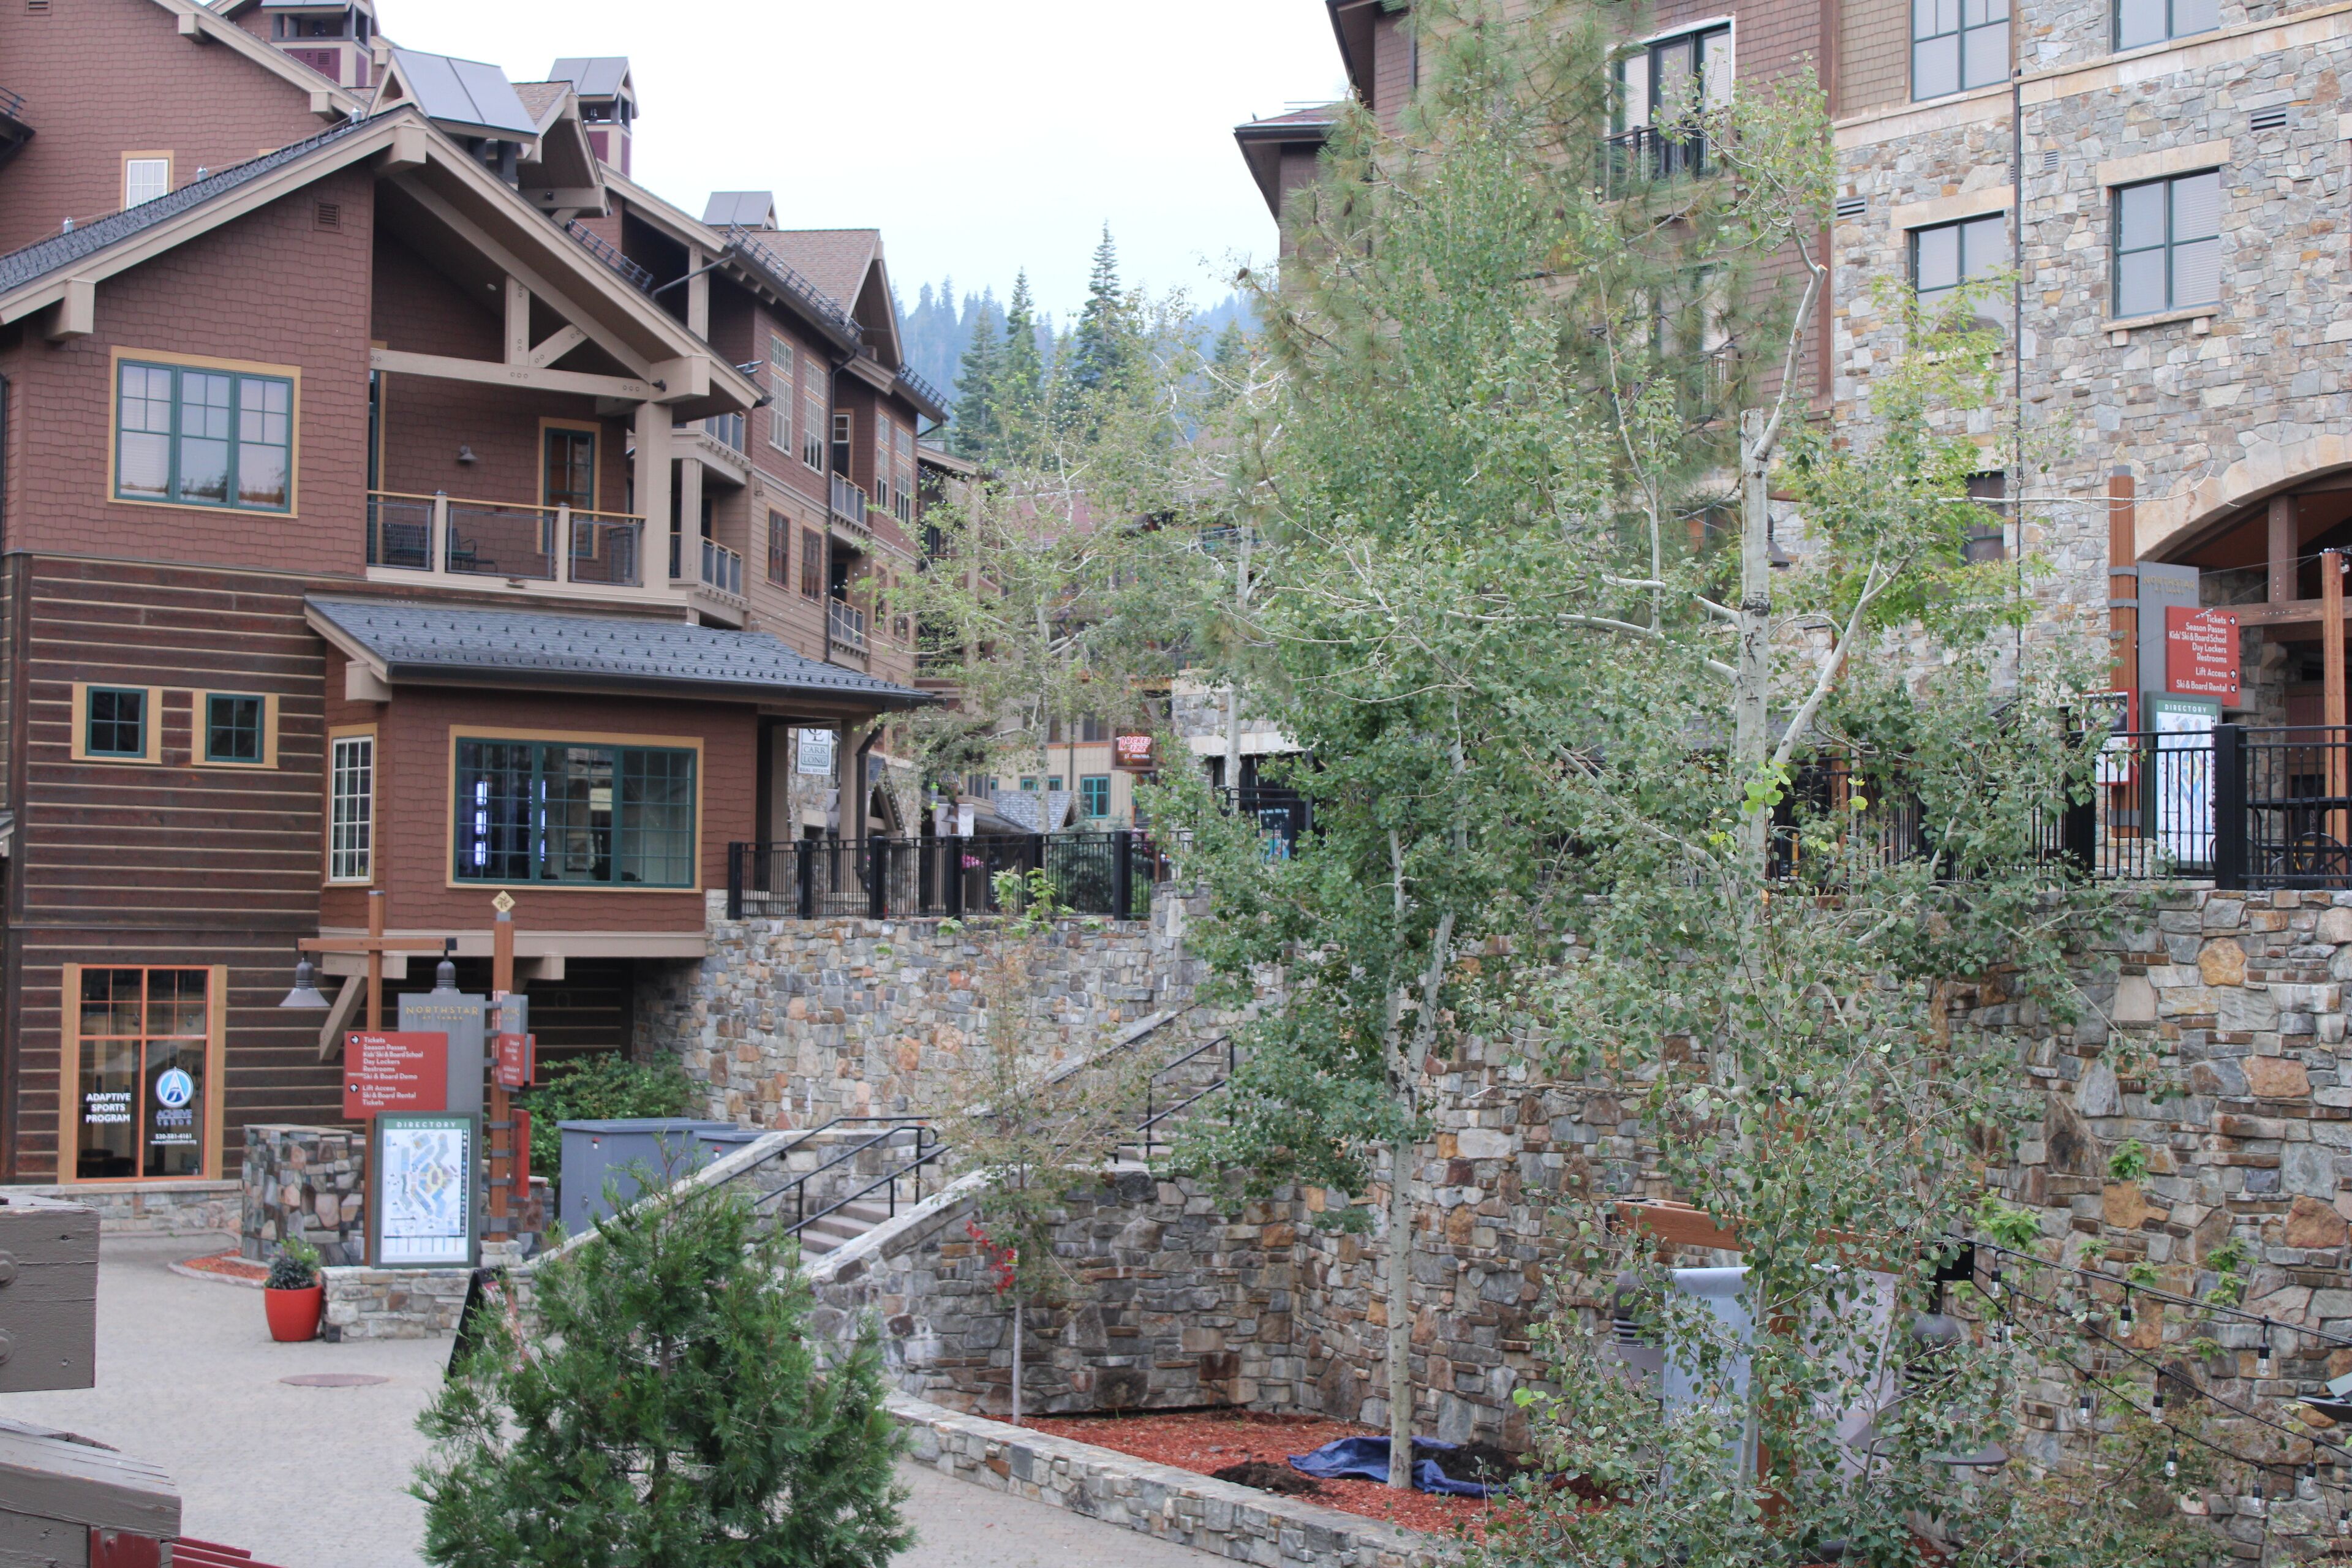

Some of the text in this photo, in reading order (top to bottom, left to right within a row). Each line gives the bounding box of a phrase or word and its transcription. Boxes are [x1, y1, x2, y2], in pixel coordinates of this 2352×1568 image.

[2206, 614, 2226, 624] Tickets
[2185, 622, 2226, 633] Season Passes
[2181, 631, 2190, 640] Ski
[2195, 633, 2209, 641] Board
[2210, 635, 2226, 643] School
[2192, 642, 2226, 654] Day Lockers
[2196, 652, 2227, 663] Restrooms
[2196, 666, 2227, 677] Lift Access
[2176, 679, 2185, 688] Ski
[2191, 681, 2207, 690] Board
[2209, 682, 2227, 692] Rental
[2164, 704, 2207, 714] DIRECTORY
[804, 745, 827, 754] CARR
[804, 756, 826, 764] LONG
[406, 1006, 478, 1015] NORTHSTAR
[86, 1093, 131, 1102] ADAPTIVE
[91, 1104, 126, 1112] SPORTS
[86, 1114, 130, 1123] PROGRAM
